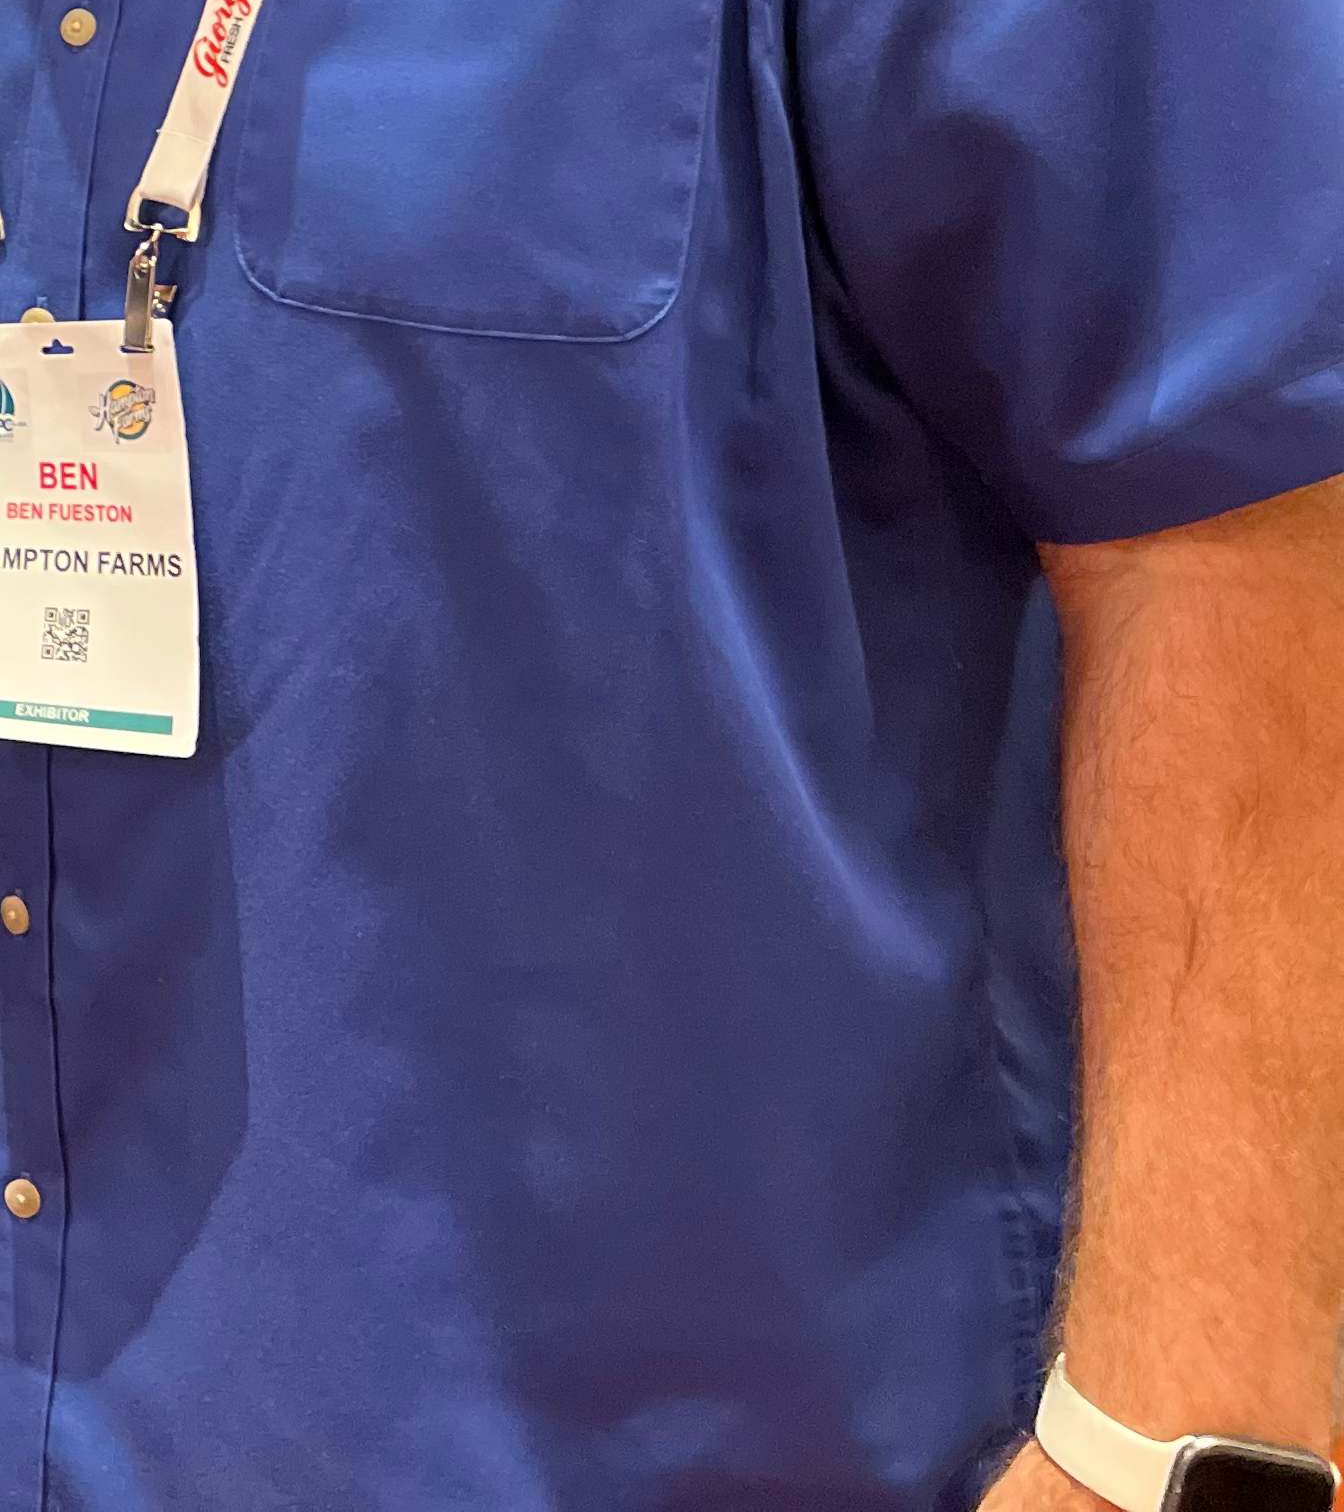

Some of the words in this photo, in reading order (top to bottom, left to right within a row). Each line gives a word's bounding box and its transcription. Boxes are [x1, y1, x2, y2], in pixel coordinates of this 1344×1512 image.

[221, 16, 244, 64] FRESH
[38, 461, 98, 491] BEN
[6, 502, 44, 521] BEN
[48, 503, 133, 524] FUESTON
[97, 551, 183, 579] FARMS
[15, 702, 91, 724] EXHIBITOR
